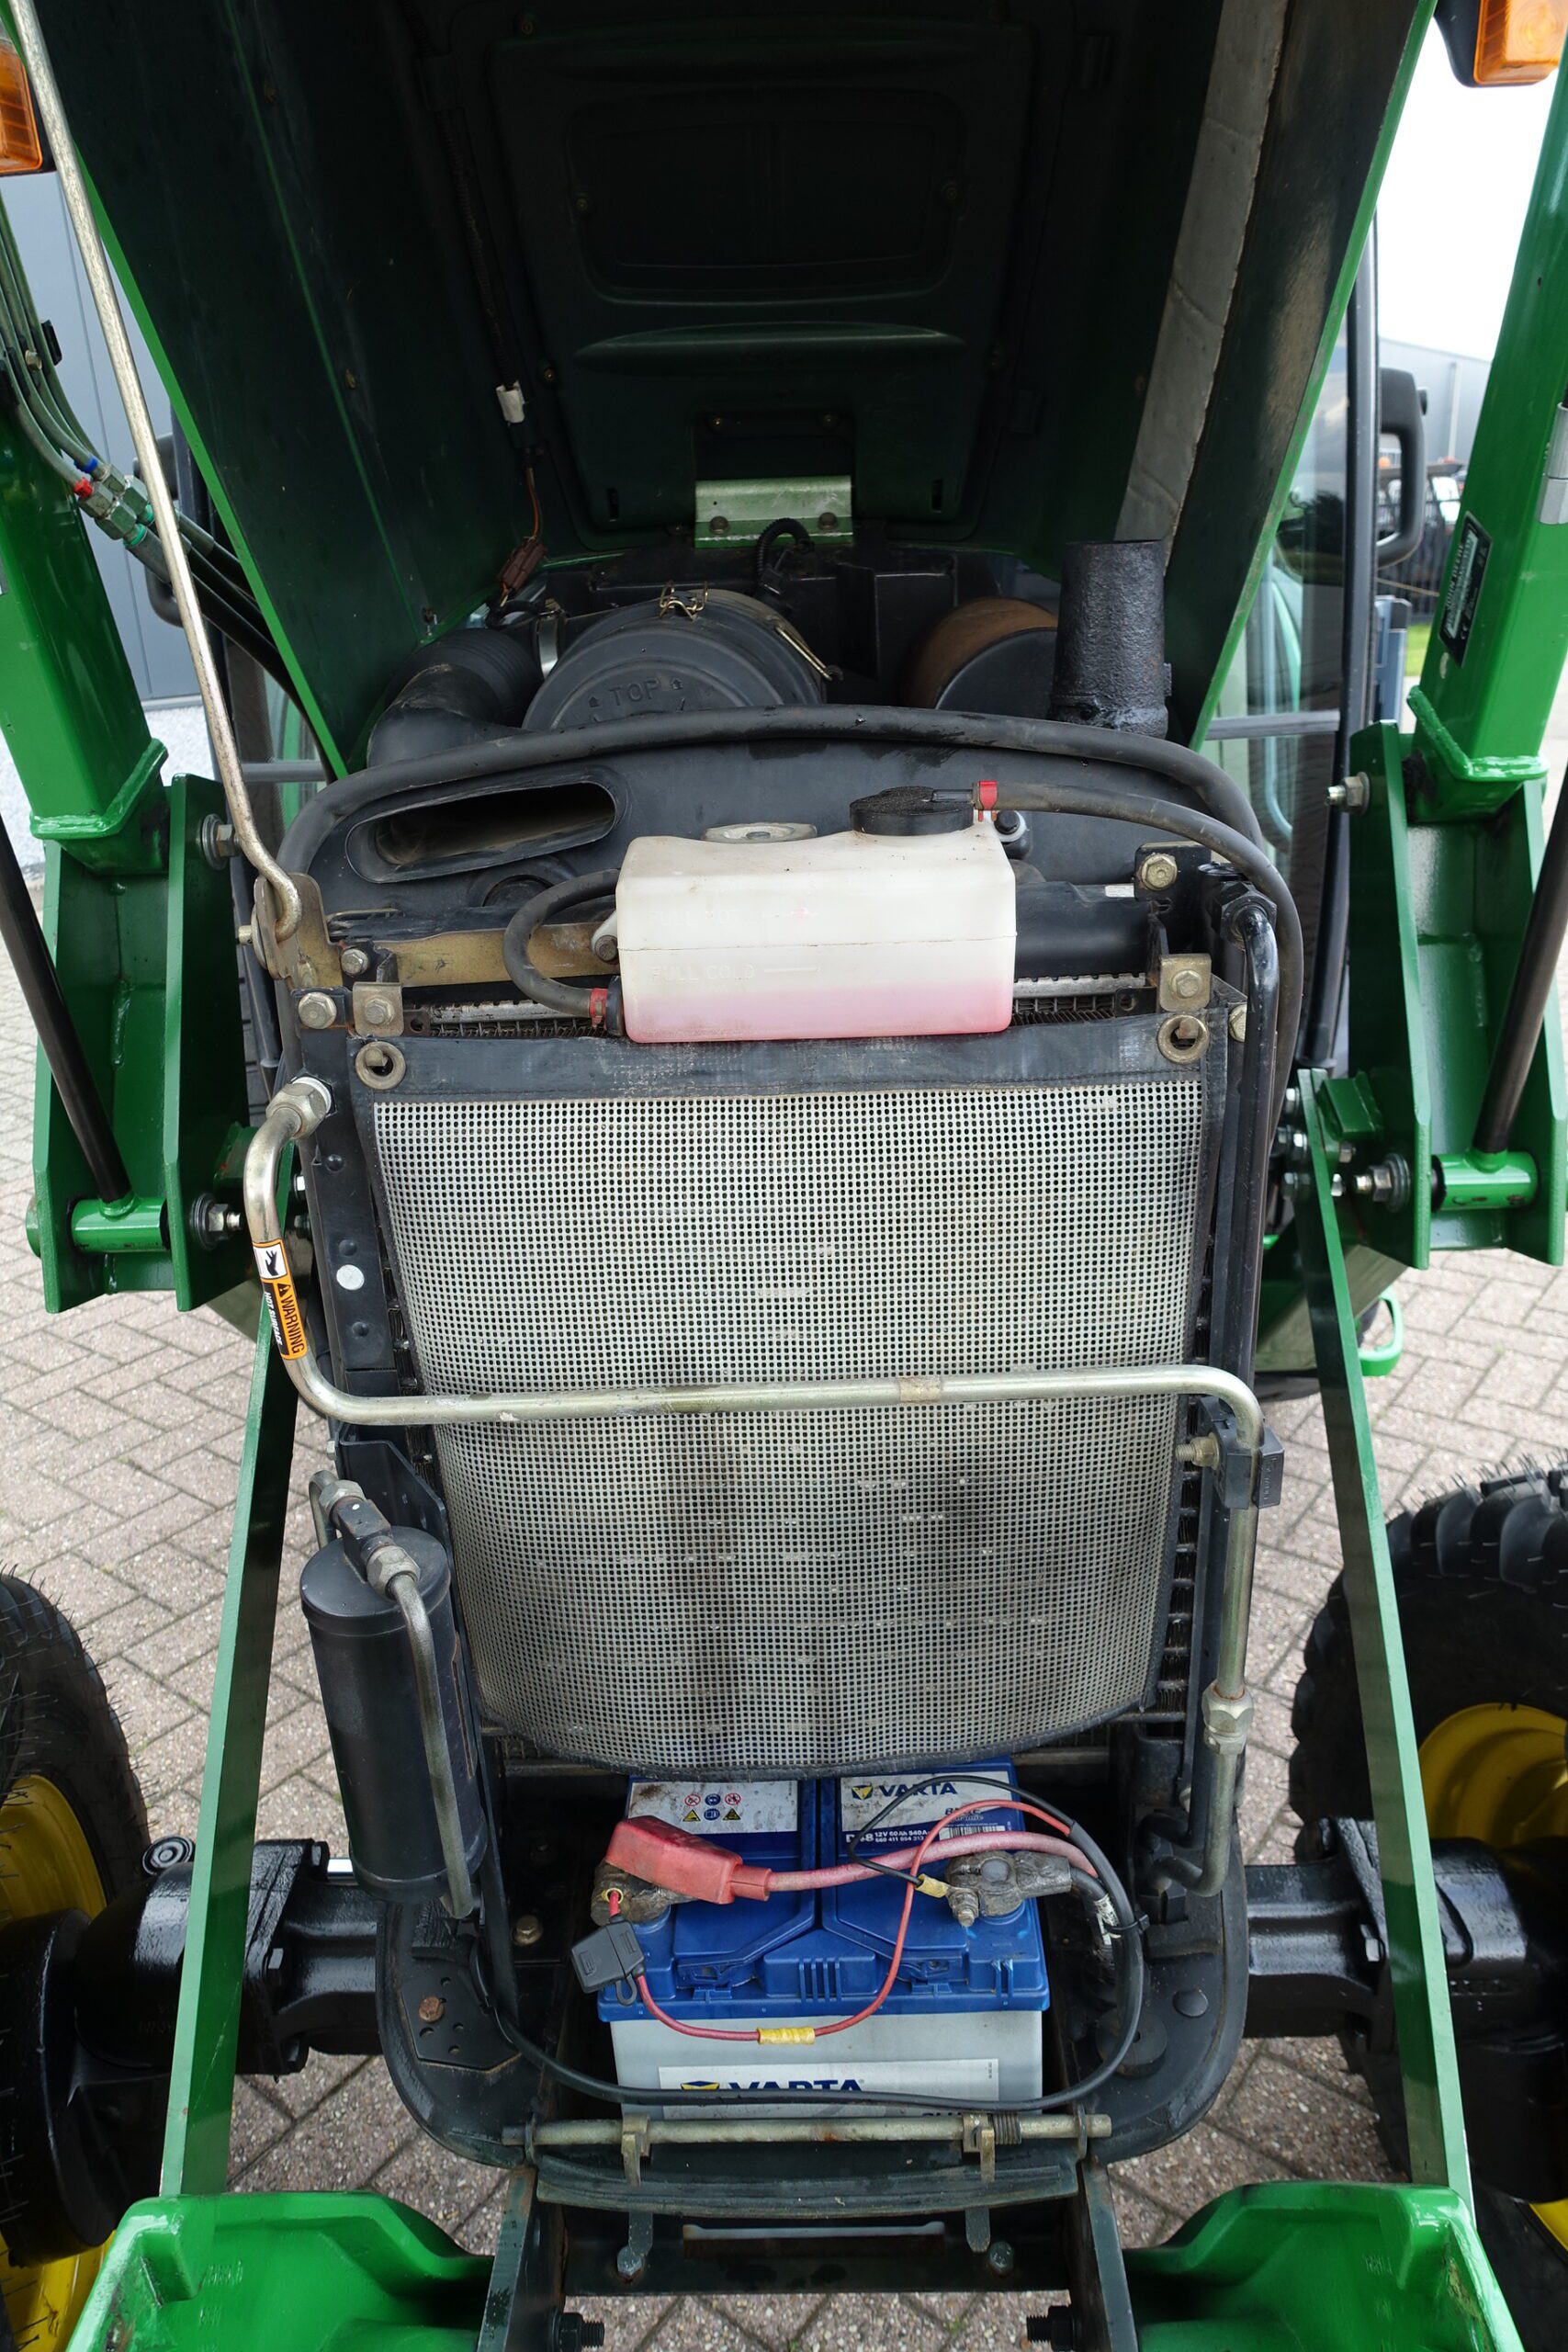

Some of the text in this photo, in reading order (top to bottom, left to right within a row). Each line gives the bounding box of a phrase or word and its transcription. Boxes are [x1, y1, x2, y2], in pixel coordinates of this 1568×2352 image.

[609, 677, 661, 707] TOP
[648, 963, 756, 983] FULL COLD
[280, 1295, 305, 1354] WARNING
